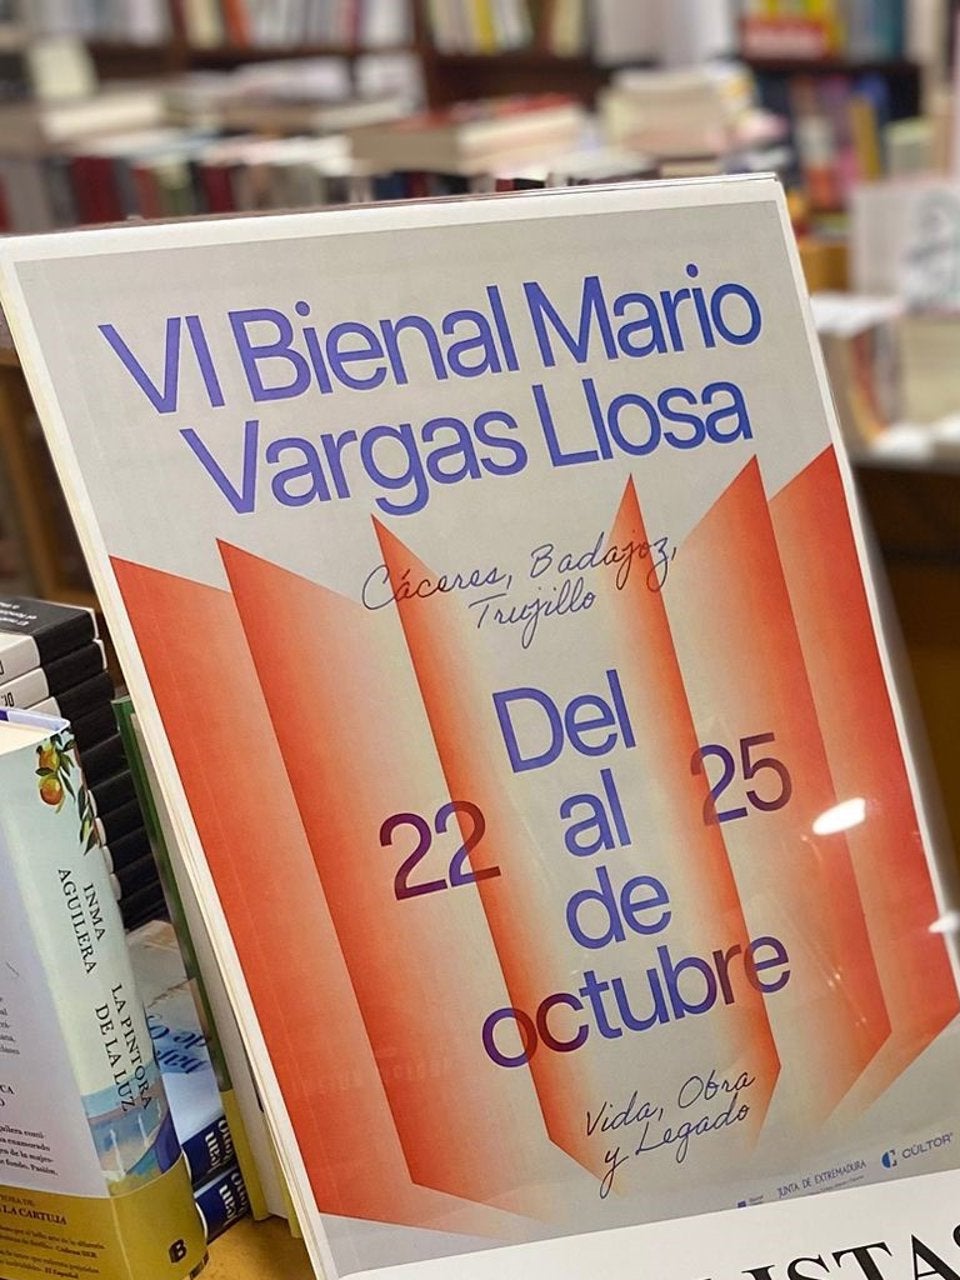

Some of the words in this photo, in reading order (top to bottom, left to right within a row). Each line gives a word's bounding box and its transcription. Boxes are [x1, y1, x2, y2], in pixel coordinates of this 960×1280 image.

[98, 316, 224, 415] VI
[227, 285, 518, 401] Bienal
[523, 263, 762, 367] Mario
[180, 409, 527, 515] Vargas
[532, 376, 752, 469] Llosa
[362, 564, 512, 611] Cáceres,
[530, 531, 677, 592] Badajoz,
[469, 576, 597, 649] Trujillo
[491, 668, 636, 775] Del
[559, 767, 633, 858] al
[689, 731, 793, 827] 25
[377, 799, 502, 902] 22
[58, 869, 97, 974] AGUILERA
[83, 883, 106, 941] INMA
[564, 867, 672, 951] de
[111, 984, 127, 1013] LA
[121, 1019, 152, 1109] PINTORA
[480, 934, 791, 1069] octubre
[95, 1004, 113, 1035] DE
[105, 1041, 121, 1067] LA
[114, 1073, 135, 1112] LUZ
[586, 1091, 663, 1136] Vida,
[678, 1070, 756, 1108] Obra
[600, 1147, 629, 1199] y
[635, 1092, 750, 1163] Legado
[777, 1184, 800, 1198] JUNTA
[802, 1177, 811, 1189] DE
[814, 1159, 867, 1185] EXTREMADURA
